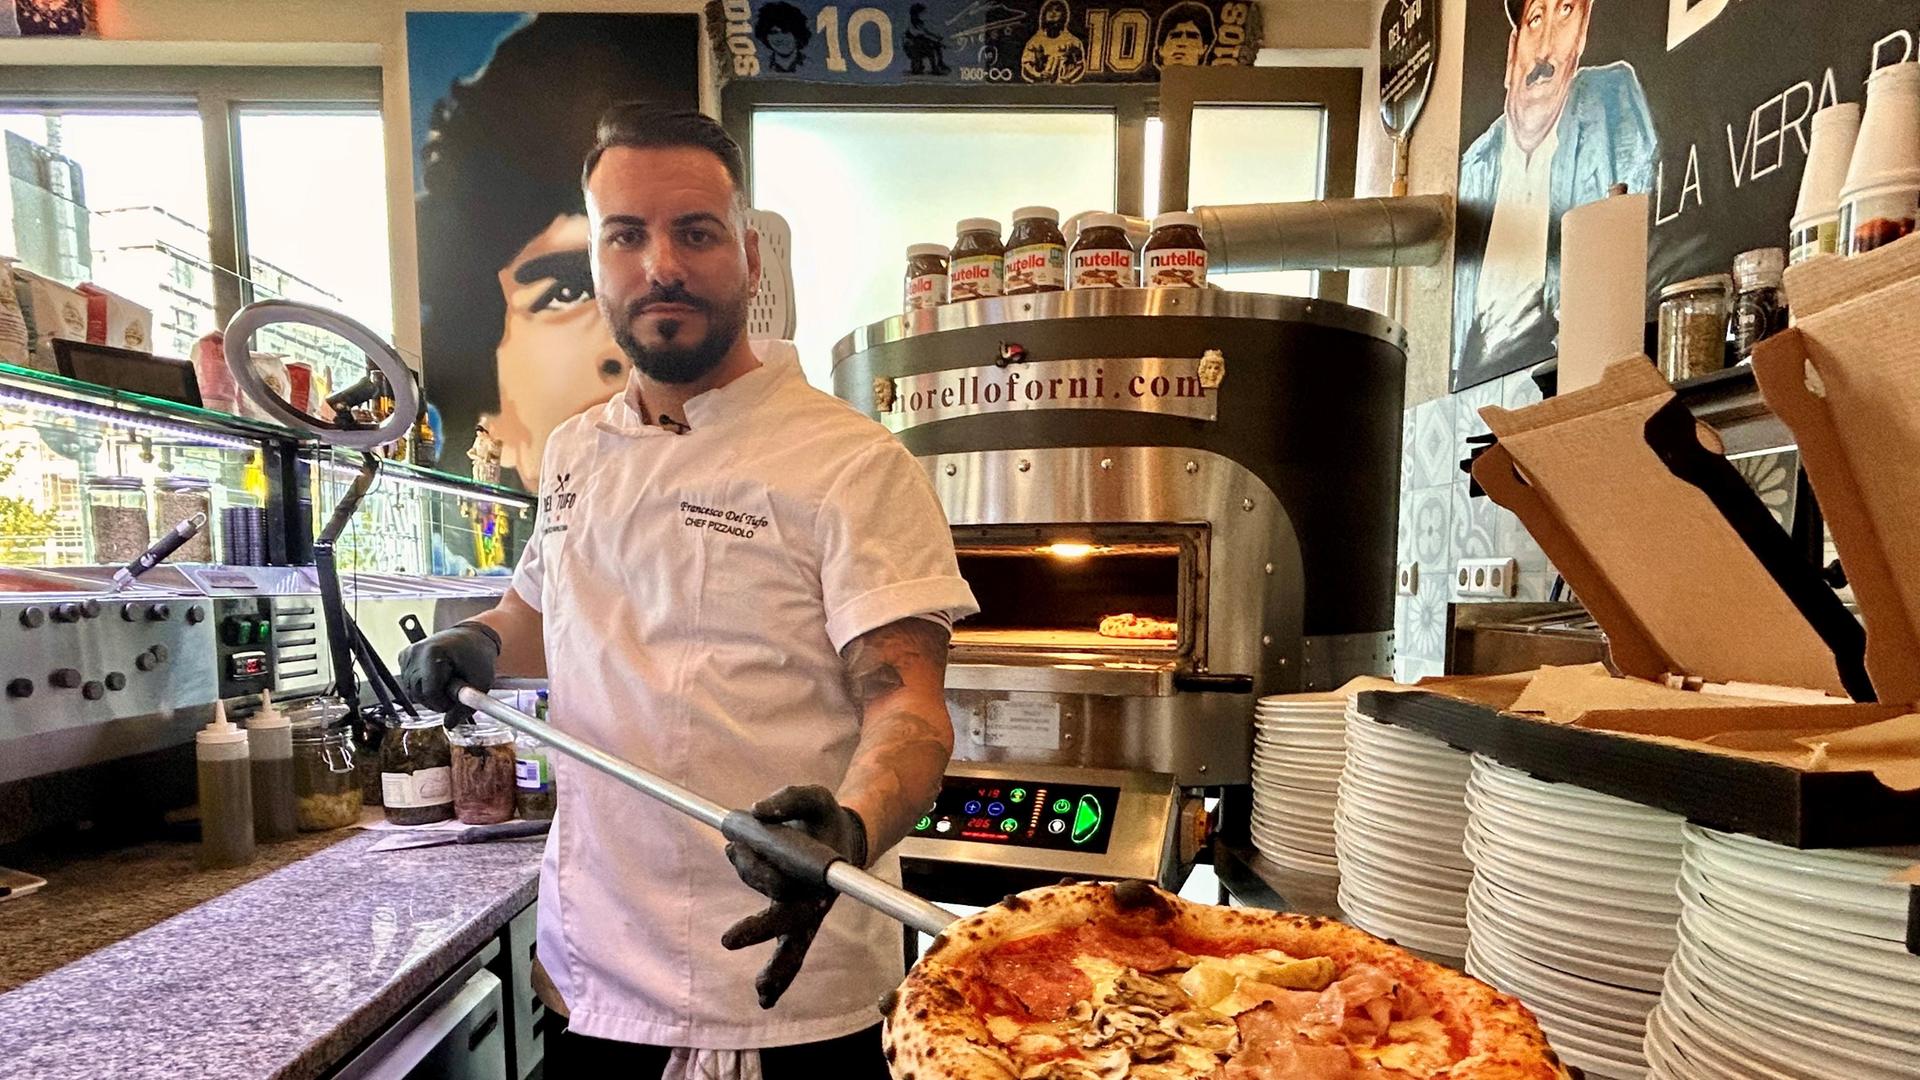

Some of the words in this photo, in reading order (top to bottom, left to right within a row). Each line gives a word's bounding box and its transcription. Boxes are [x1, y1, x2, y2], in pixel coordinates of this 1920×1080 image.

[816, 6, 894, 72] 10
[1085, 8, 1151, 73] 10
[1655, 143, 1703, 226] LA
[1075, 250, 1130, 268] nutella
[1150, 250, 1205, 268] nutella
[680, 501, 723, 517] Francesco
[725, 510, 747, 523] Del
[746, 514, 769, 529] Tufo
[685, 517, 707, 528] CHEF
[708, 520, 754, 539] PIZZAIOLO
